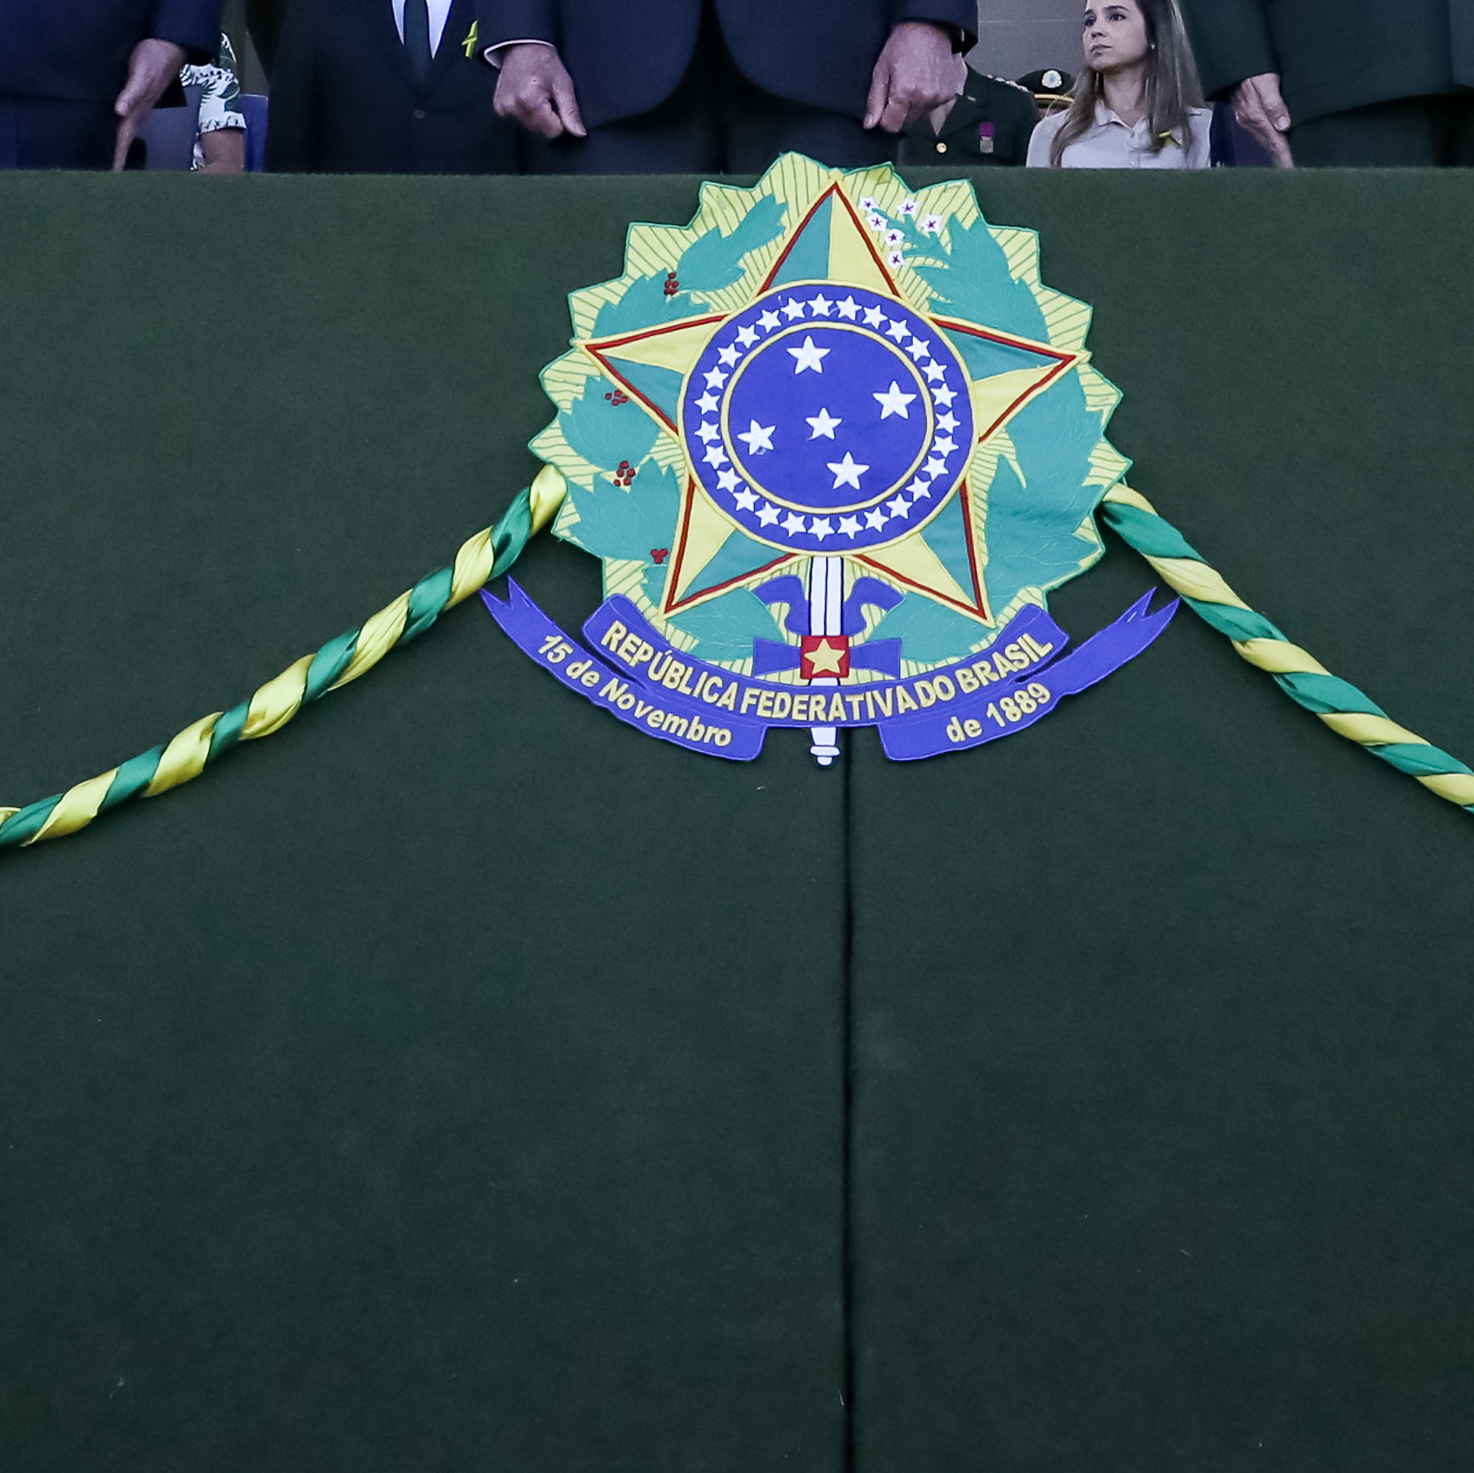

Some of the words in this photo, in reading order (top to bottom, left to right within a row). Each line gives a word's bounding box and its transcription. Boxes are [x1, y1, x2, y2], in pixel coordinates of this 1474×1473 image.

[537, 635, 574, 663] 15
[565, 659, 601, 687] de
[599, 679, 732, 747] Novembro
[600, 620, 739, 711] REPÚBLICA
[955, 633, 1054, 694] BRASIL
[946, 716, 983, 743] de
[985, 682, 1051, 728] 1889
